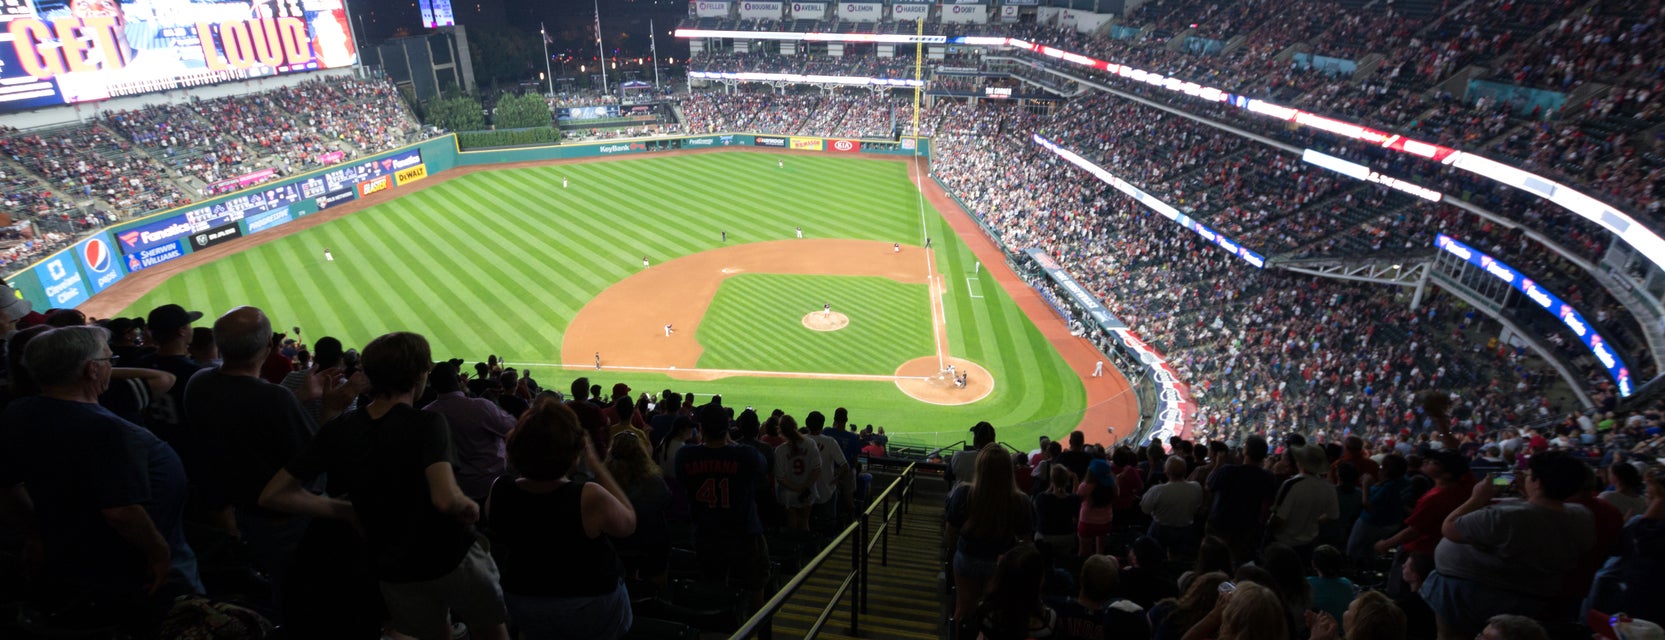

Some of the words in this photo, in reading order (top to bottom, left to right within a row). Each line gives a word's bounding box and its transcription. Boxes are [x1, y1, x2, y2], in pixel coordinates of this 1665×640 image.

[7, 16, 129, 80] GET
[195, 16, 311, 71] LOUD
[600, 145, 630, 153] KeyBank
[141, 222, 191, 244] Fanatics
[209, 227, 236, 241] RAM
[45, 272, 81, 297] Cleveland
[98, 269, 117, 287] pepsi
[57, 287, 79, 304] Clinic
[793, 458, 805, 476] 9
[695, 477, 731, 509] 41
